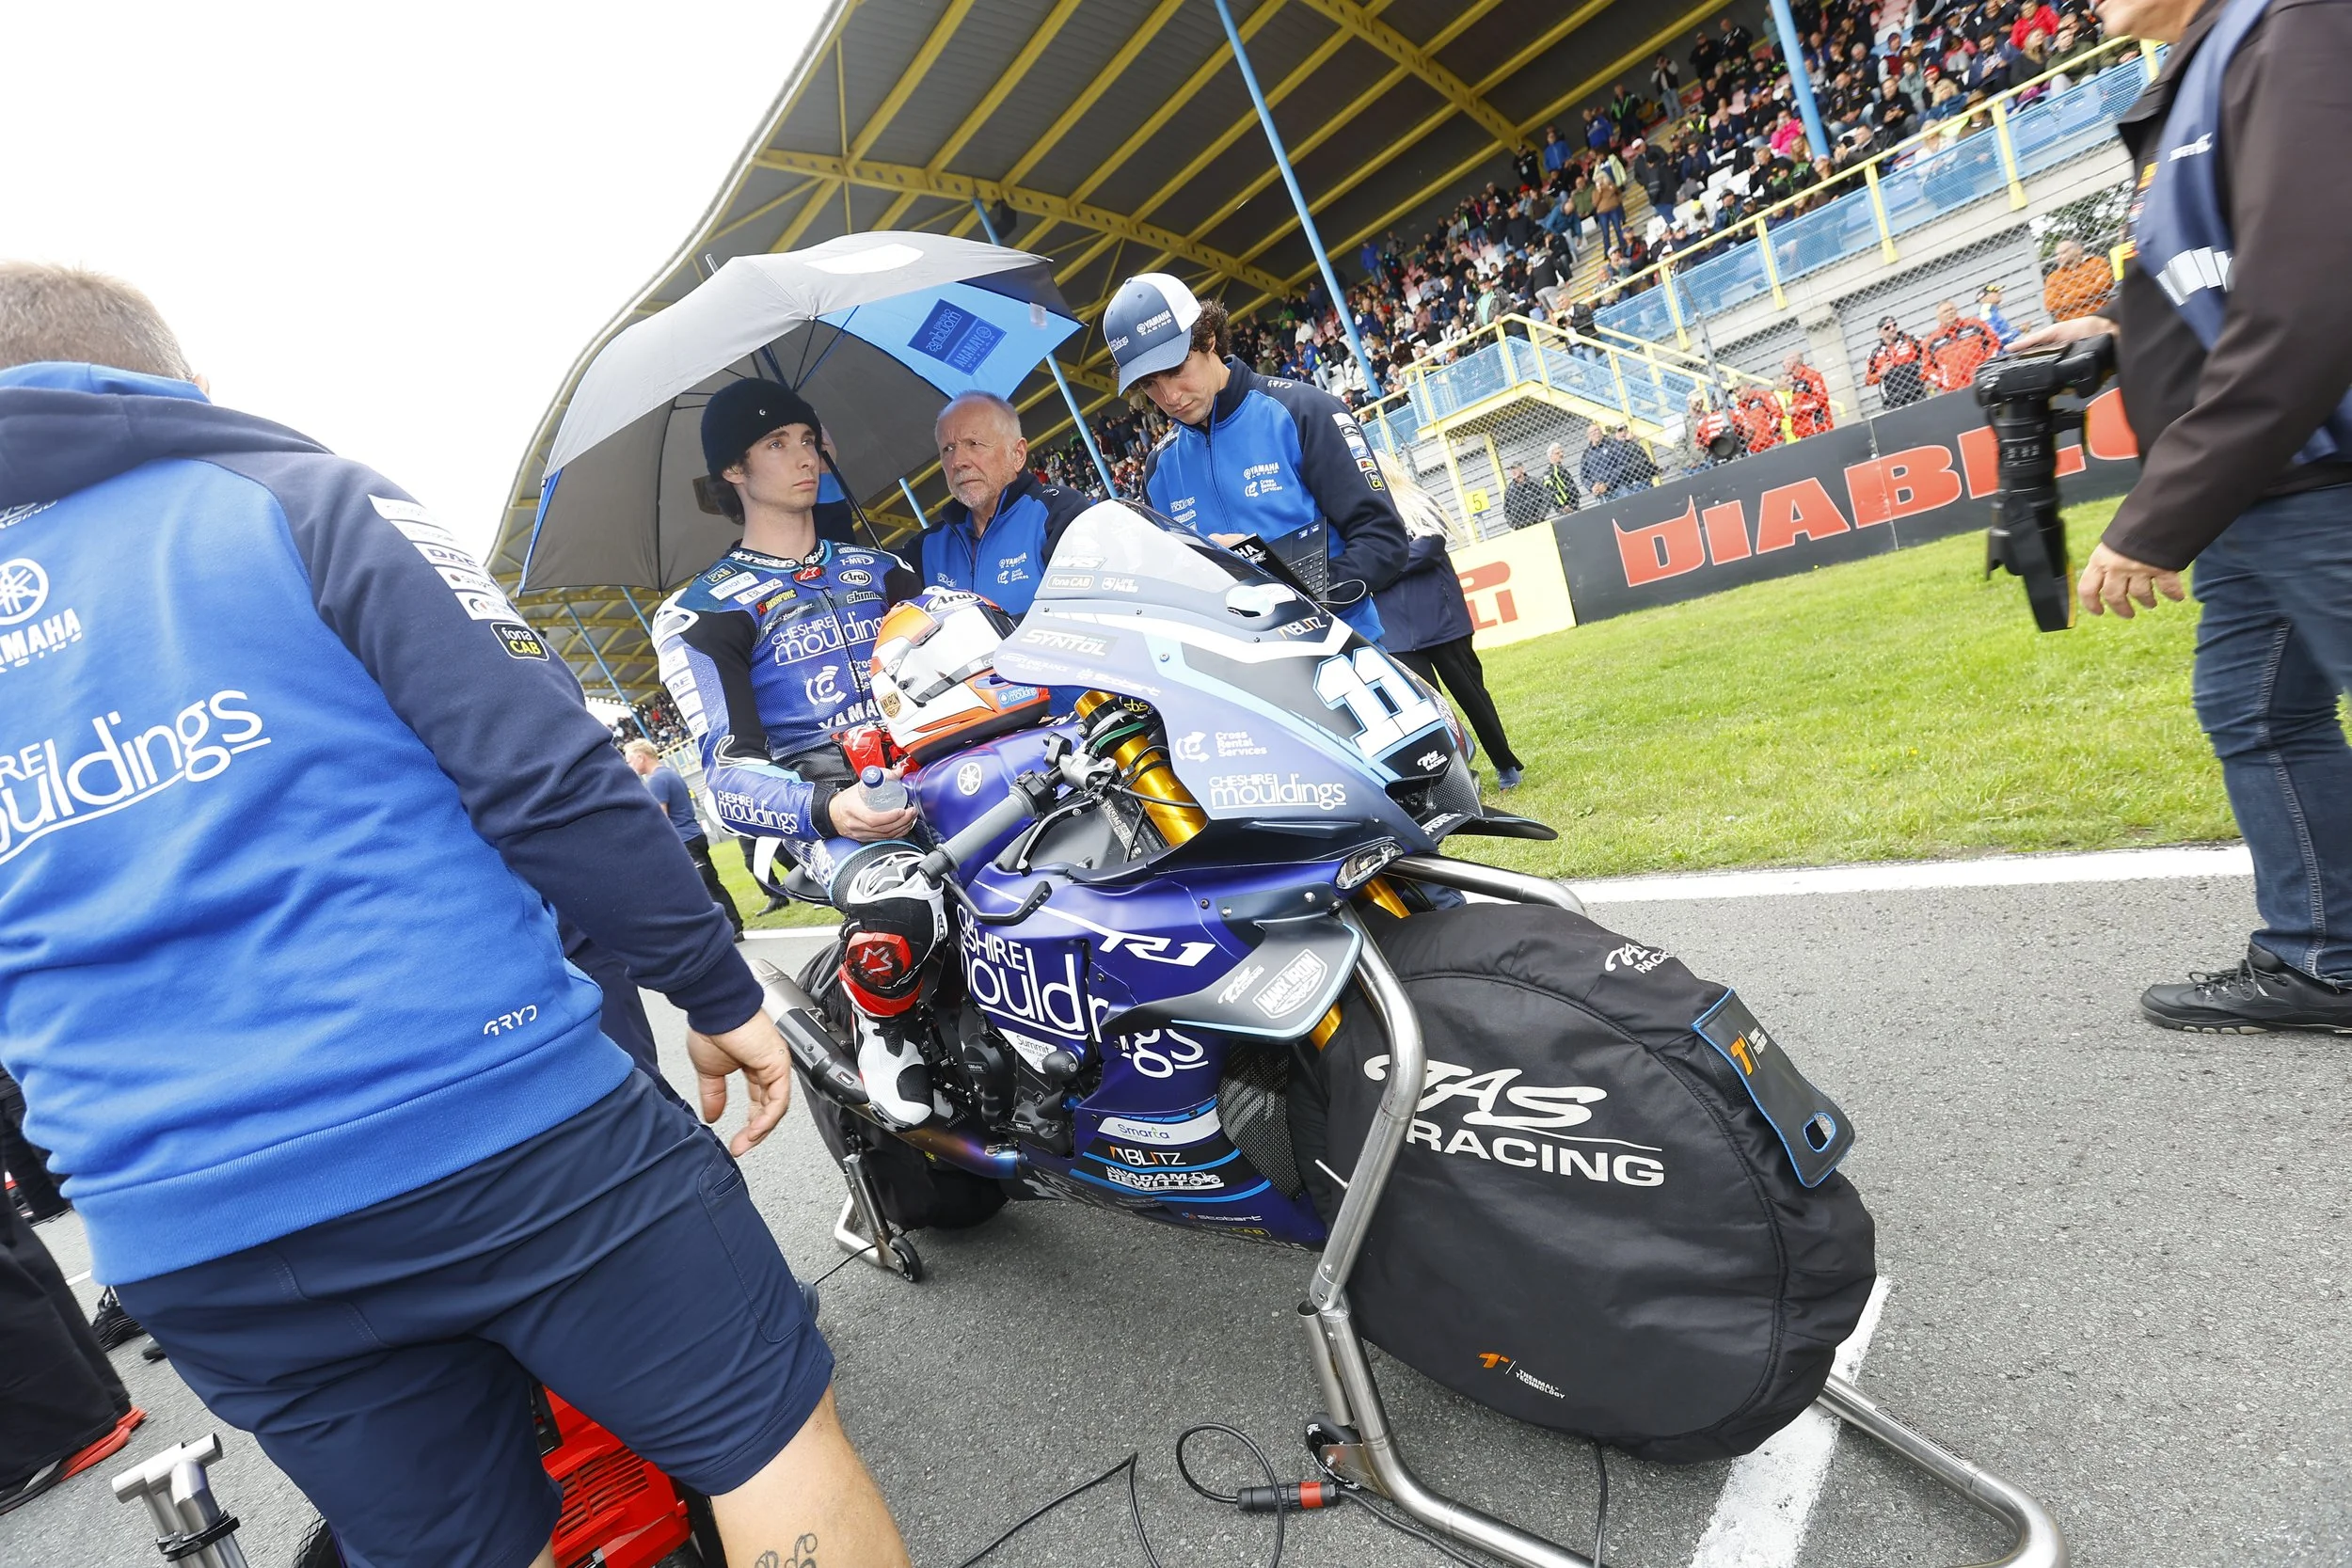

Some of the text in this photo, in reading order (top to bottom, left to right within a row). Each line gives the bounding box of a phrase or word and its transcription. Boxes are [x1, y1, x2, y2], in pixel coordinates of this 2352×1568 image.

[1144, 309, 1171, 327] YAMAHA
[1141, 319, 1172, 336] RACING
[1249, 462, 1279, 474] YAMAHA
[1471, 493, 1483, 511] 5
[729, 550, 797, 568] alpinestars
[845, 572, 867, 582] Arai
[1070, 578, 1090, 588] CAB
[932, 593, 975, 611] Arai
[0, 608, 82, 664] MAHA
[501, 626, 532, 641] fona
[771, 616, 834, 645] CHESHIRE
[774, 610, 882, 664] mouldin
[509, 641, 542, 656] CAB
[1021, 628, 1107, 657] SYNTOL
[1123, 699, 1150, 712] sbs
[1314, 647, 1442, 758] 11
[818, 699, 880, 730] YAMA
[1215, 731, 1248, 741] Cross
[1216, 738, 1254, 749] Rental
[1217, 746, 1268, 757] Services
[0, 690, 271, 842] uldings
[1425, 756, 1449, 771] RACING
[1208, 773, 1273, 788] CHESHIRE
[718, 790, 752, 807] CHESHIRE
[1210, 773, 1347, 811] mouldings
[718, 798, 800, 834] mouldings
[1016, 1035, 1050, 1054] Summit
[1117, 1123, 1170, 1140] Smarta
[1406, 1117, 1665, 1187] RACING
[1107, 1172, 1189, 1187] HEWITT
[1127, 1171, 1187, 1182] ADAM
[1515, 1371, 1566, 1400] TECHNOLOGY
[1518, 1369, 1555, 1391] THERMAL
